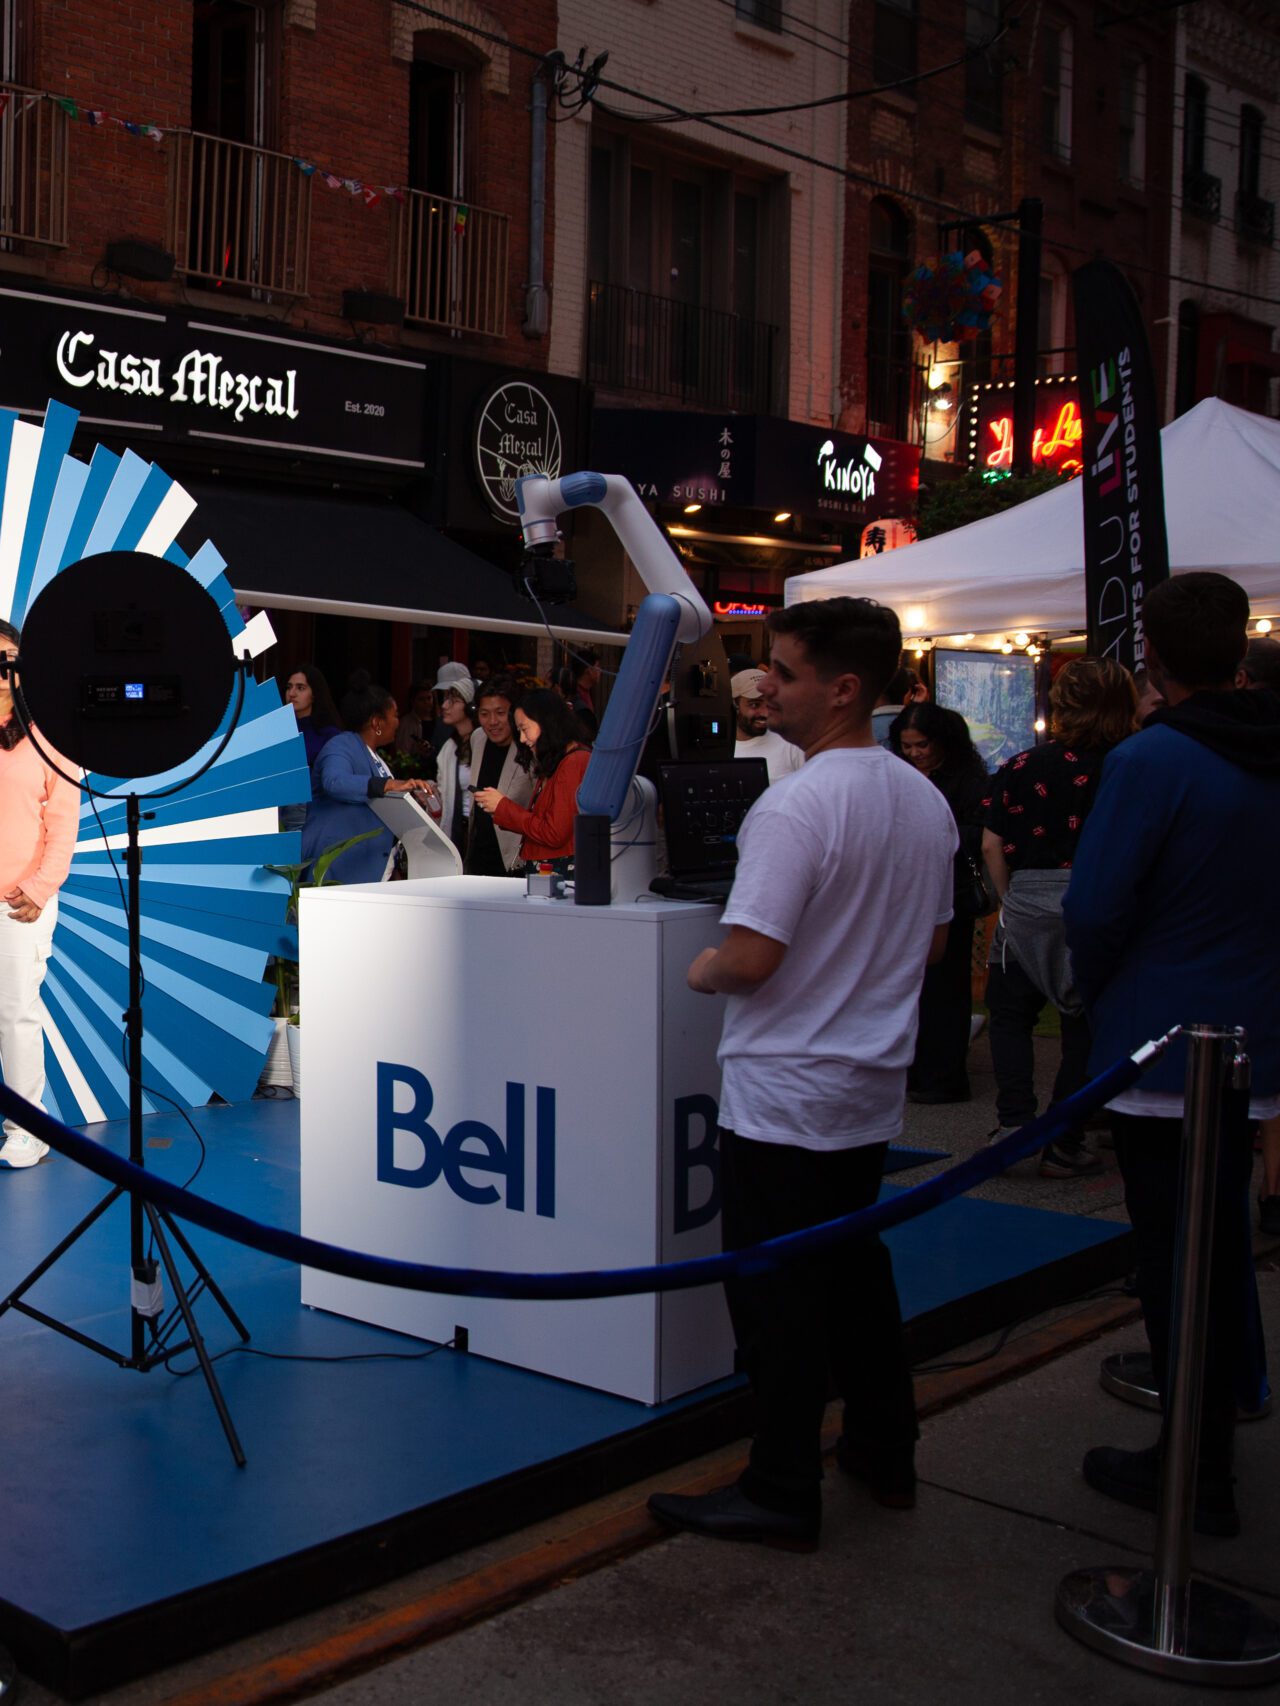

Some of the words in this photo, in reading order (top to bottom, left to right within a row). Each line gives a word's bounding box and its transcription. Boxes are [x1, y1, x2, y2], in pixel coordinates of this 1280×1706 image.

[56, 331, 164, 397] Casa
[169, 349, 299, 422] Mezcal
[345, 400, 362, 414] Est.
[363, 402, 385, 417] 2020
[504, 402, 538, 426] Casa
[1118, 345, 1140, 502] STUDENTS
[498, 433, 543, 460] Mezcal
[718, 427, 734, 479] 木の屋
[672, 485, 726, 502] SUSHI
[824, 458, 875, 502] KINOYA
[865, 526, 886, 557] 寿
[1129, 508, 1144, 573] FOR
[377, 1061, 555, 1218] Bell
[674, 1093, 721, 1235] B
